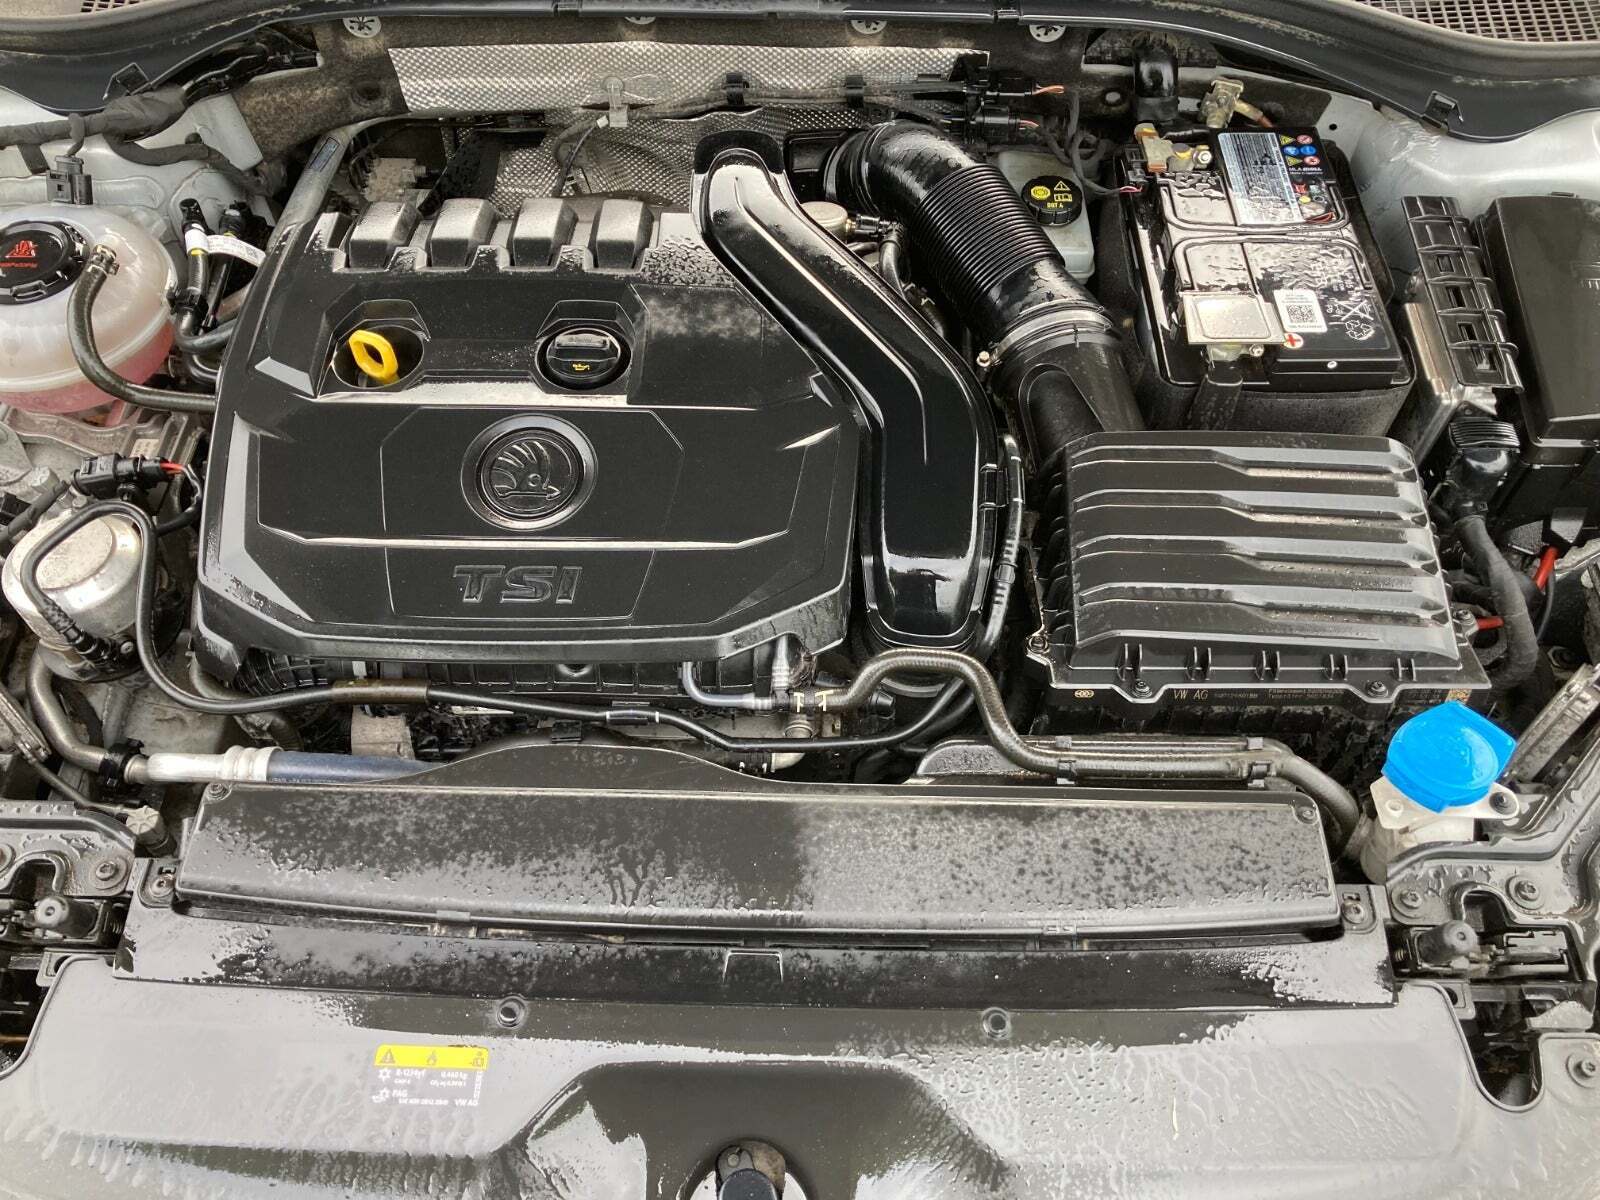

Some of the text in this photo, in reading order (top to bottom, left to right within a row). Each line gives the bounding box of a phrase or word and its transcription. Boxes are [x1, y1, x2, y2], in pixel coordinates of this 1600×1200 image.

[452, 564, 583, 604] TSI
[1173, 690, 1188, 700] VW
[1193, 689, 1209, 700] AG
[392, 1089, 408, 1098] PAG
[454, 1098, 468, 1106] VW
